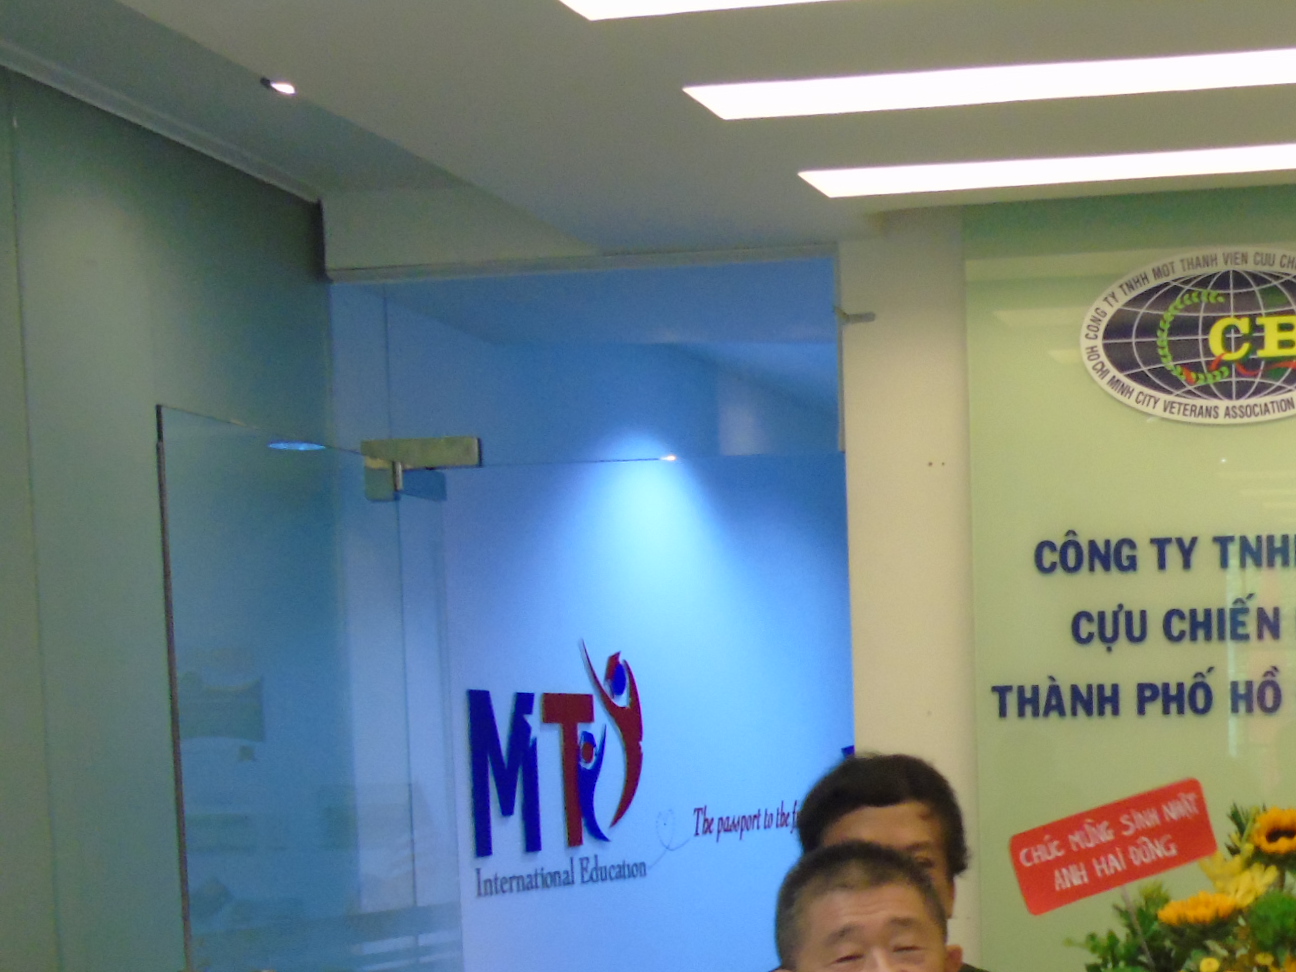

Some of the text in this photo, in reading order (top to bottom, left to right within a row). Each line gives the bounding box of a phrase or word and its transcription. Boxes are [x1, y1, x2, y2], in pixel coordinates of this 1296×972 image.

[1103, 291, 1120, 309] TY
[1118, 271, 1151, 297] TNHH
[1091, 360, 1111, 381] CHI
[1106, 374, 1136, 400] MINH
[1135, 391, 1160, 410] CITY
[1162, 400, 1220, 419] VETERANS
[1223, 397, 1296, 419] ASSOCIATION
[1034, 529, 1139, 577] CÔNG
[1150, 536, 1199, 572] TY
[1071, 603, 1149, 652] CỰU
[1162, 593, 1281, 644] CHIẾN
[991, 675, 1121, 720] THÀNH
[1136, 666, 1215, 717] PHỐ
[1229, 667, 1283, 716] HỒ
[693, 804, 715, 838] The
[716, 806, 762, 843] passport
[763, 808, 774, 830] to
[775, 800, 790, 829] the
[474, 852, 648, 899] International Education
